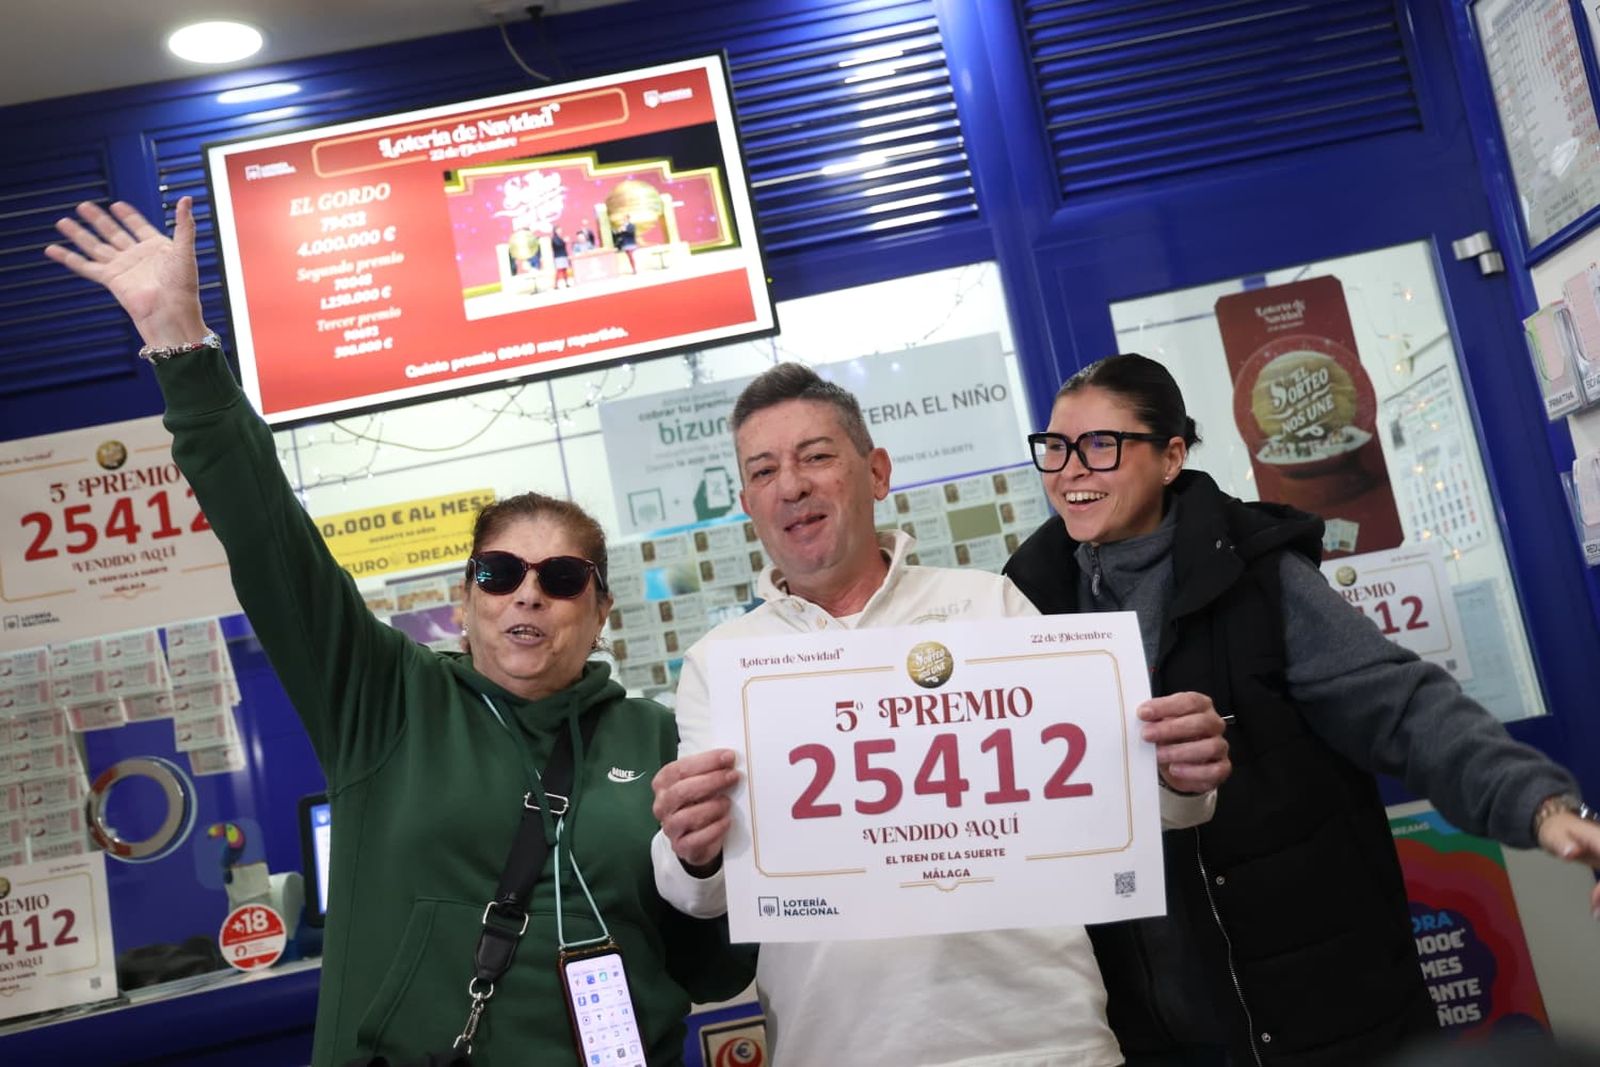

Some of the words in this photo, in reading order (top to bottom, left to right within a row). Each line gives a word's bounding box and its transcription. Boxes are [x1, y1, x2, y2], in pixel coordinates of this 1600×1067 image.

[452, 124, 478, 143] de
[290, 198, 314, 216] EL
[318, 183, 391, 210] GORDO
[297, 230, 380, 256] 4.000.000
[383, 226, 396, 241] €
[297, 260, 355, 282] Segundo
[355, 251, 404, 273] premio
[317, 316, 356, 332] Tercer
[358, 306, 402, 328] premio
[451, 352, 496, 372] premio
[537, 339, 565, 352] muy
[922, 396, 948, 415] EL
[952, 383, 1007, 410] NIÑO
[1282, 411, 1306, 434] NOS
[1307, 394, 1334, 421] UNE
[78, 463, 181, 498] PREMIO
[392, 510, 404, 525] €
[409, 506, 436, 522] AL
[72, 553, 136, 573] VENDIDO
[1030, 633, 1044, 643] 22
[1044, 632, 1057, 643] de
[1058, 631, 1113, 643] Diciembre
[782, 653, 795, 664] de
[797, 648, 845, 663] Navidad
[835, 700, 864, 732] 5º
[878, 686, 1033, 728] PREMIO
[611, 766, 636, 779] NIKE
[788, 722, 1093, 820] 25412
[862, 822, 958, 845] VENDIDO
[965, 812, 1020, 840] AQUÍ
[886, 856, 898, 865] EL
[900, 853, 929, 863] TREN
[931, 852, 945, 862] DE
[948, 851, 962, 860] LA
[964, 848, 1006, 859] SUERTE
[923, 867, 971, 880] MÁLAGA
[783, 897, 827, 908] LOTERÍA
[784, 907, 840, 917] NACIONAL
[231, 909, 269, 934] +18
[1420, 956, 1463, 980] MES
